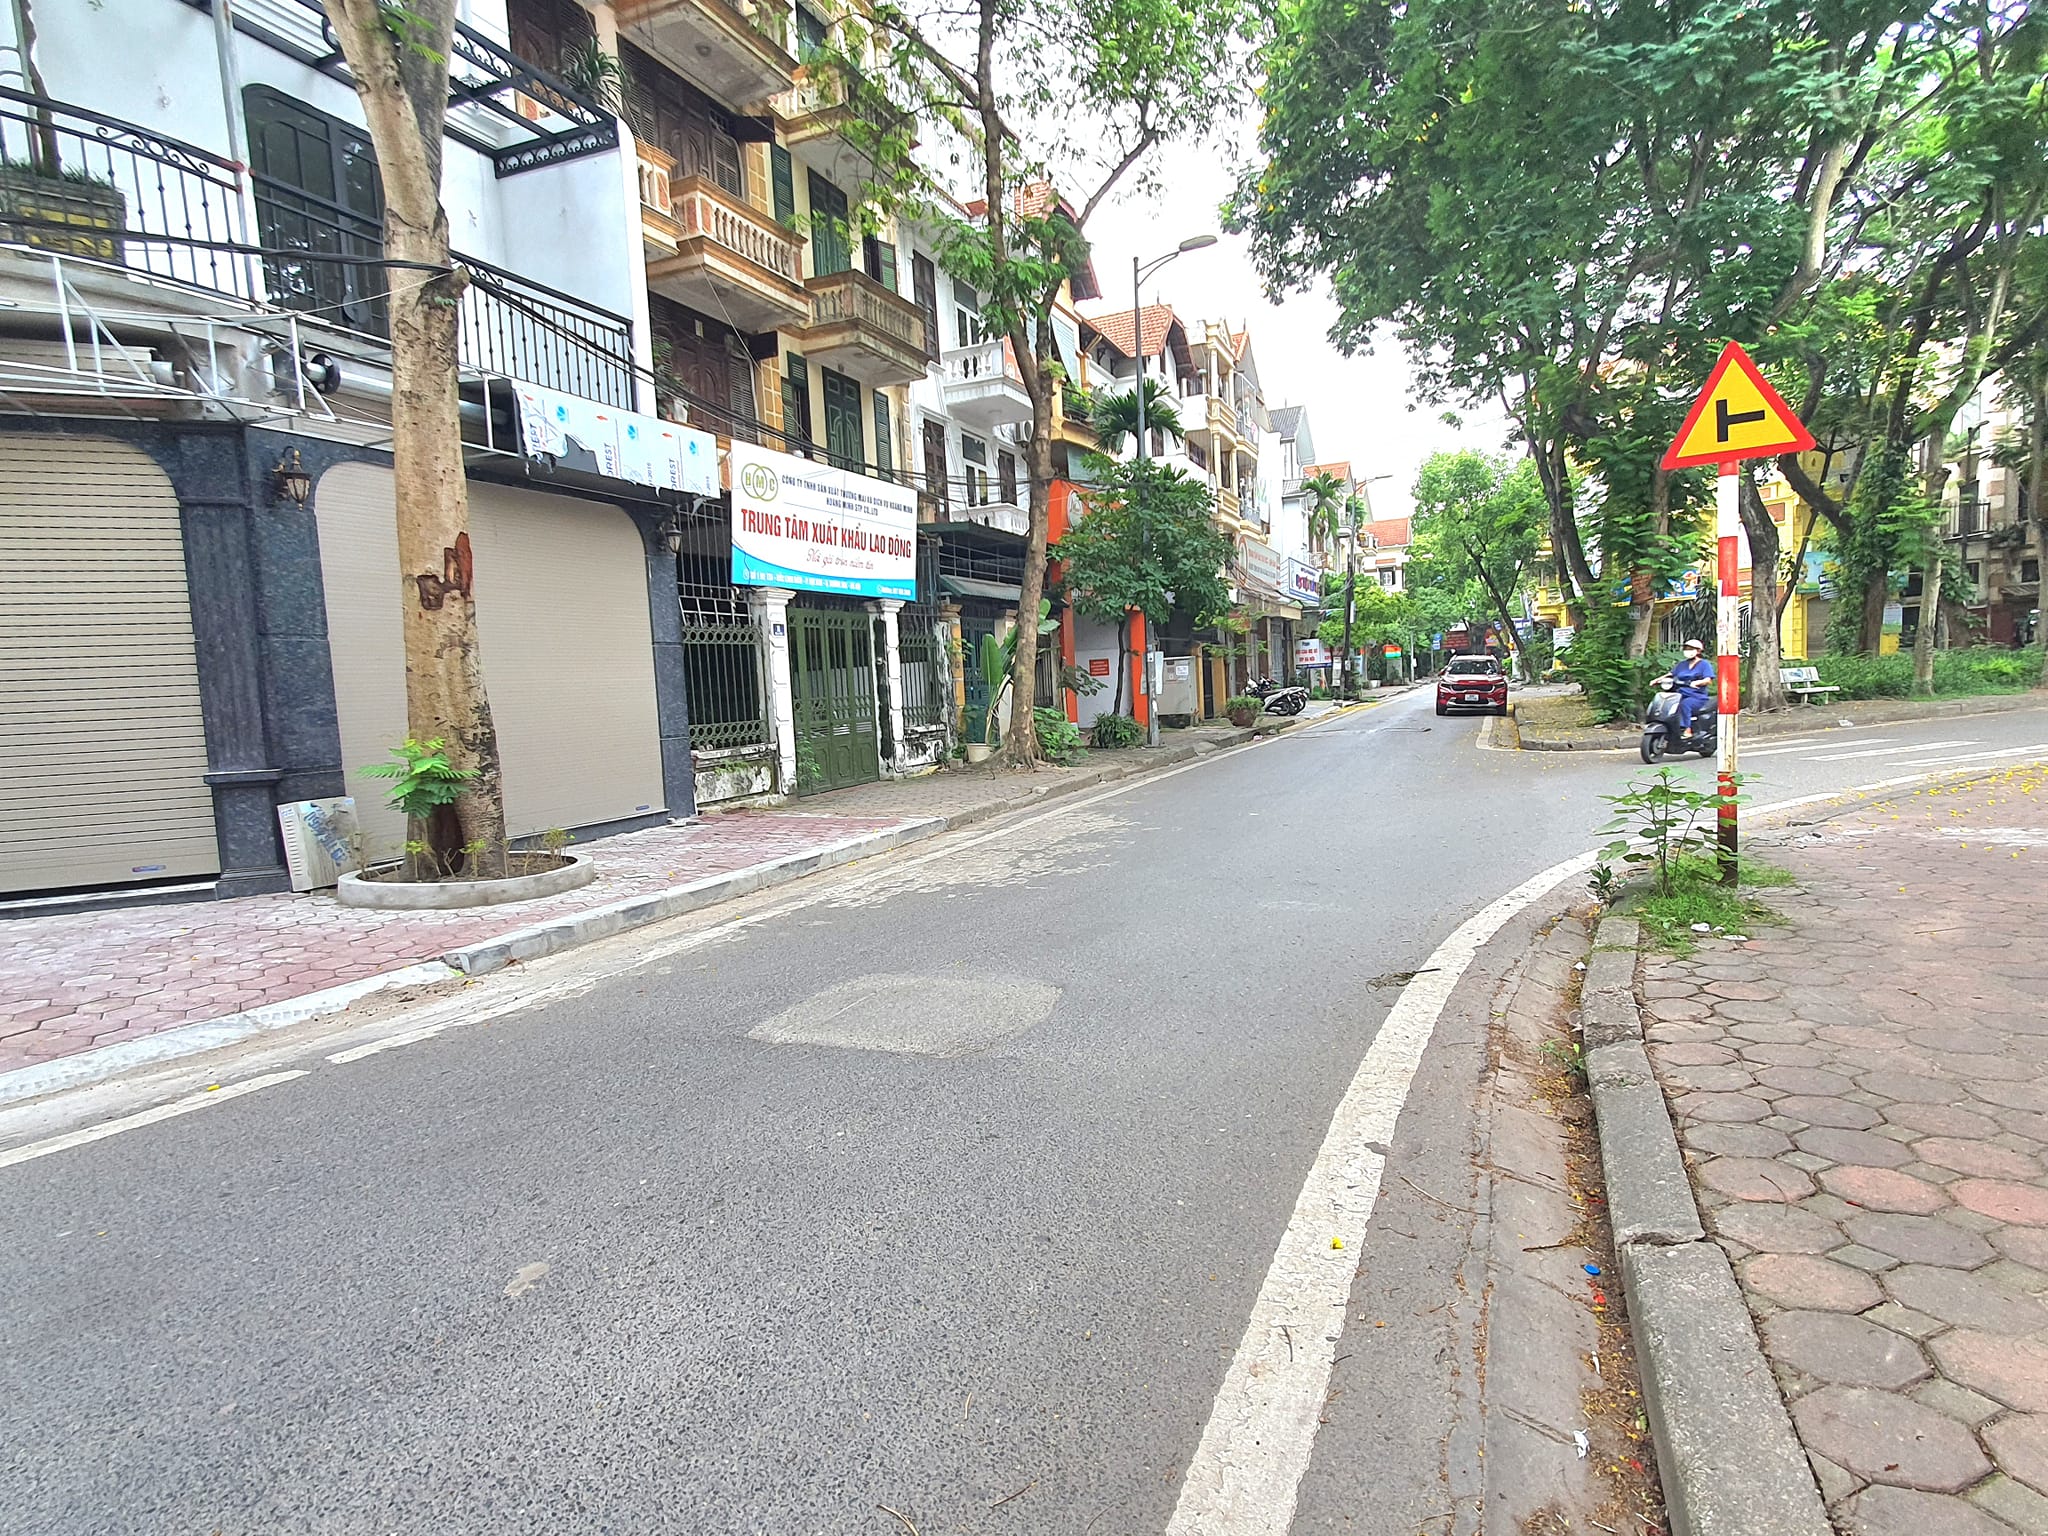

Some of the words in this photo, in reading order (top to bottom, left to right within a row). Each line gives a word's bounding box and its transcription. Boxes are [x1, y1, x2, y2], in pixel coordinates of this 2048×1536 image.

[741, 508, 781, 537] TRUNG
[785, 513, 808, 541] TÂM
[812, 518, 838, 546] XUẤT
[841, 522, 866, 551] KHẨU
[870, 532, 886, 554] LAO
[888, 534, 911, 560] ĐỘNG
